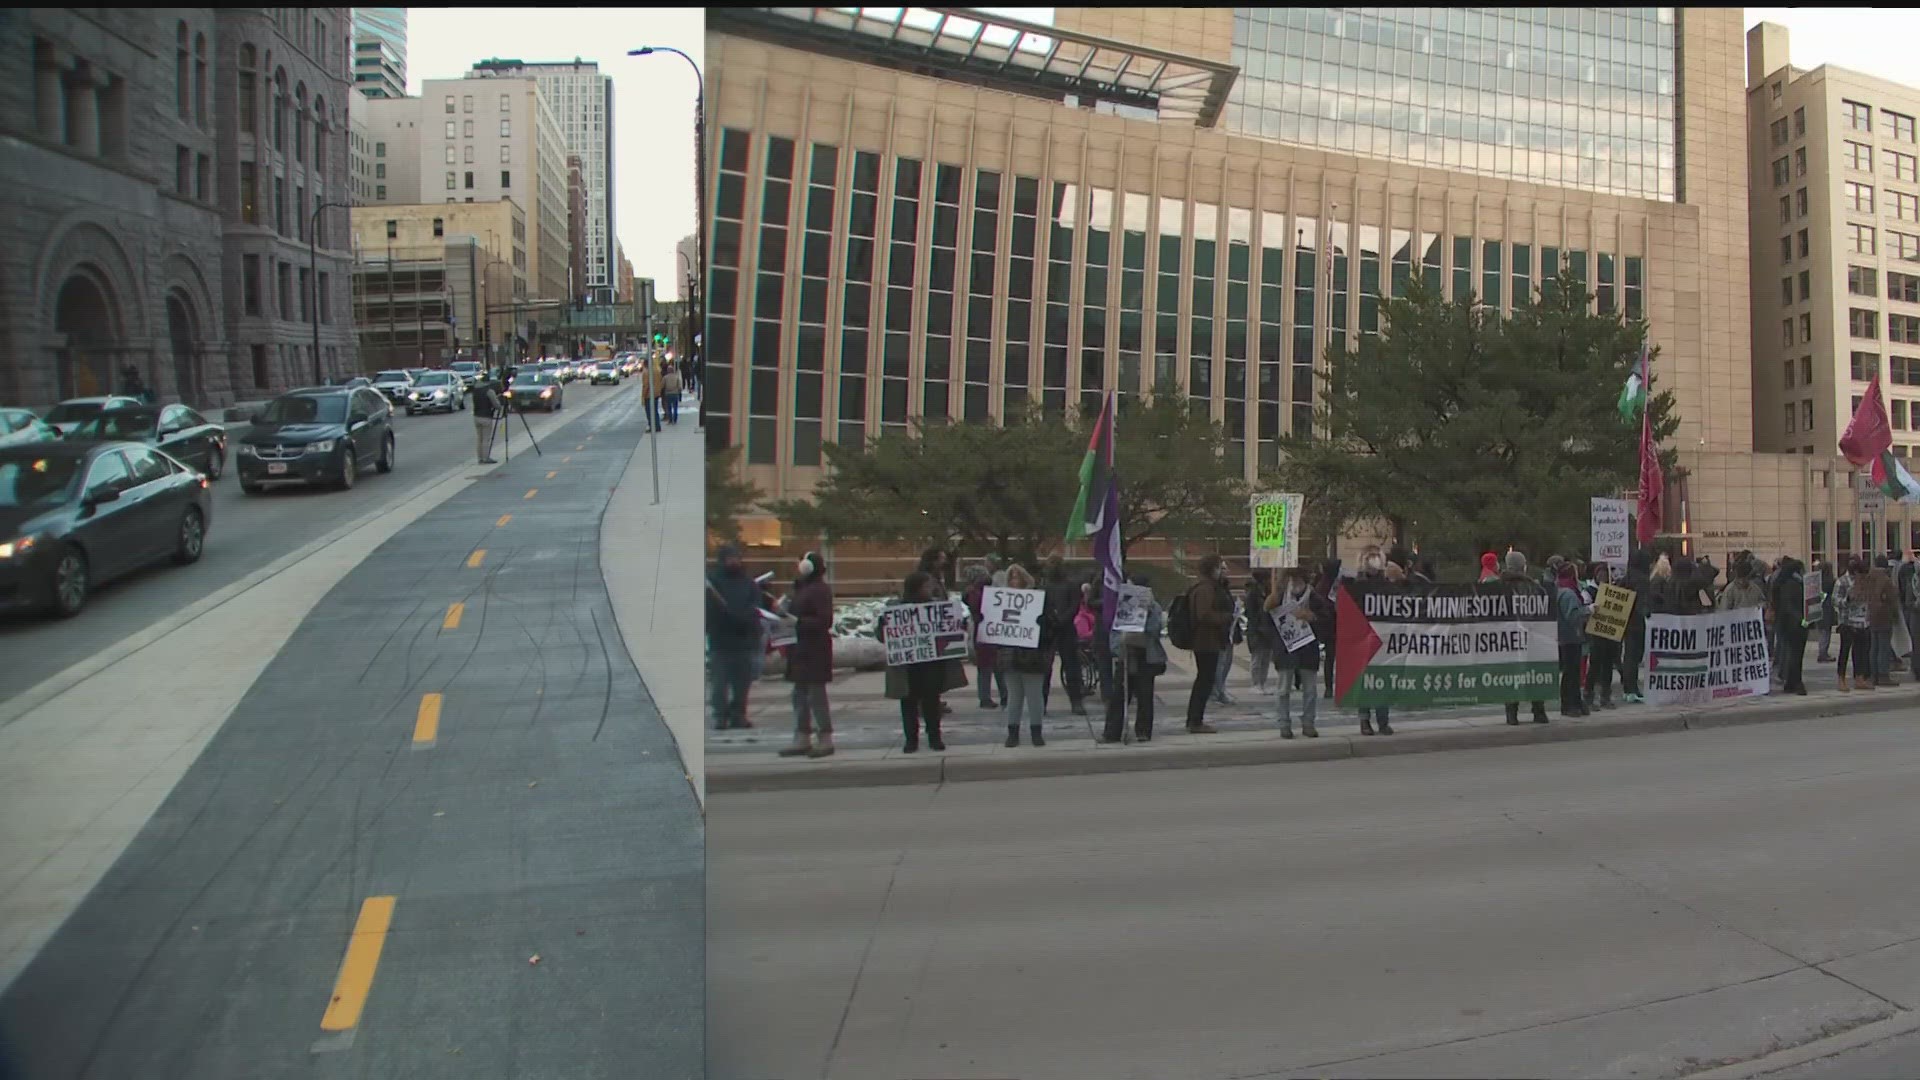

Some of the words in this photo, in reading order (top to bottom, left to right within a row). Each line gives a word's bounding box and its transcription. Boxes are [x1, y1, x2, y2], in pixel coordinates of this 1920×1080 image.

[1255, 503, 1283, 518] CEASE
[1256, 516, 1282, 530] FIRE
[992, 590, 1034, 610] STOP
[1364, 593, 1423, 618] DIVEST
[1426, 594, 1508, 618] MINNESOTA
[1512, 594, 1549, 616] FROM
[1604, 586, 1630, 602] Israel
[884, 607, 920, 626] FROM
[923, 602, 954, 622] THE
[885, 623, 917, 639] RIVER
[919, 622, 930, 634] TO
[930, 619, 946, 633] THE
[985, 621, 1034, 640] GENOCIDE
[1650, 627, 1697, 650] FROM
[1706, 625, 1725, 648] THE
[1730, 619, 1763, 643] RIVER
[1386, 632, 1471, 656] APARTHEID
[1475, 631, 1528, 653] ISRAEL!
[1710, 650, 1721, 668] TO
[1724, 647, 1742, 666] THE
[1744, 642, 1766, 662] SEA
[1363, 673, 1385, 691] No
[1389, 673, 1416, 690] Tax
[1423, 672, 1452, 692] $$$
[1458, 672, 1477, 689] for
[1481, 669, 1553, 690] Occupation
[1649, 673, 1706, 691] PALESTINE
[1707, 669, 1729, 687] WILL
[1732, 665, 1742, 683] BE
[1744, 662, 1769, 682] FREE
